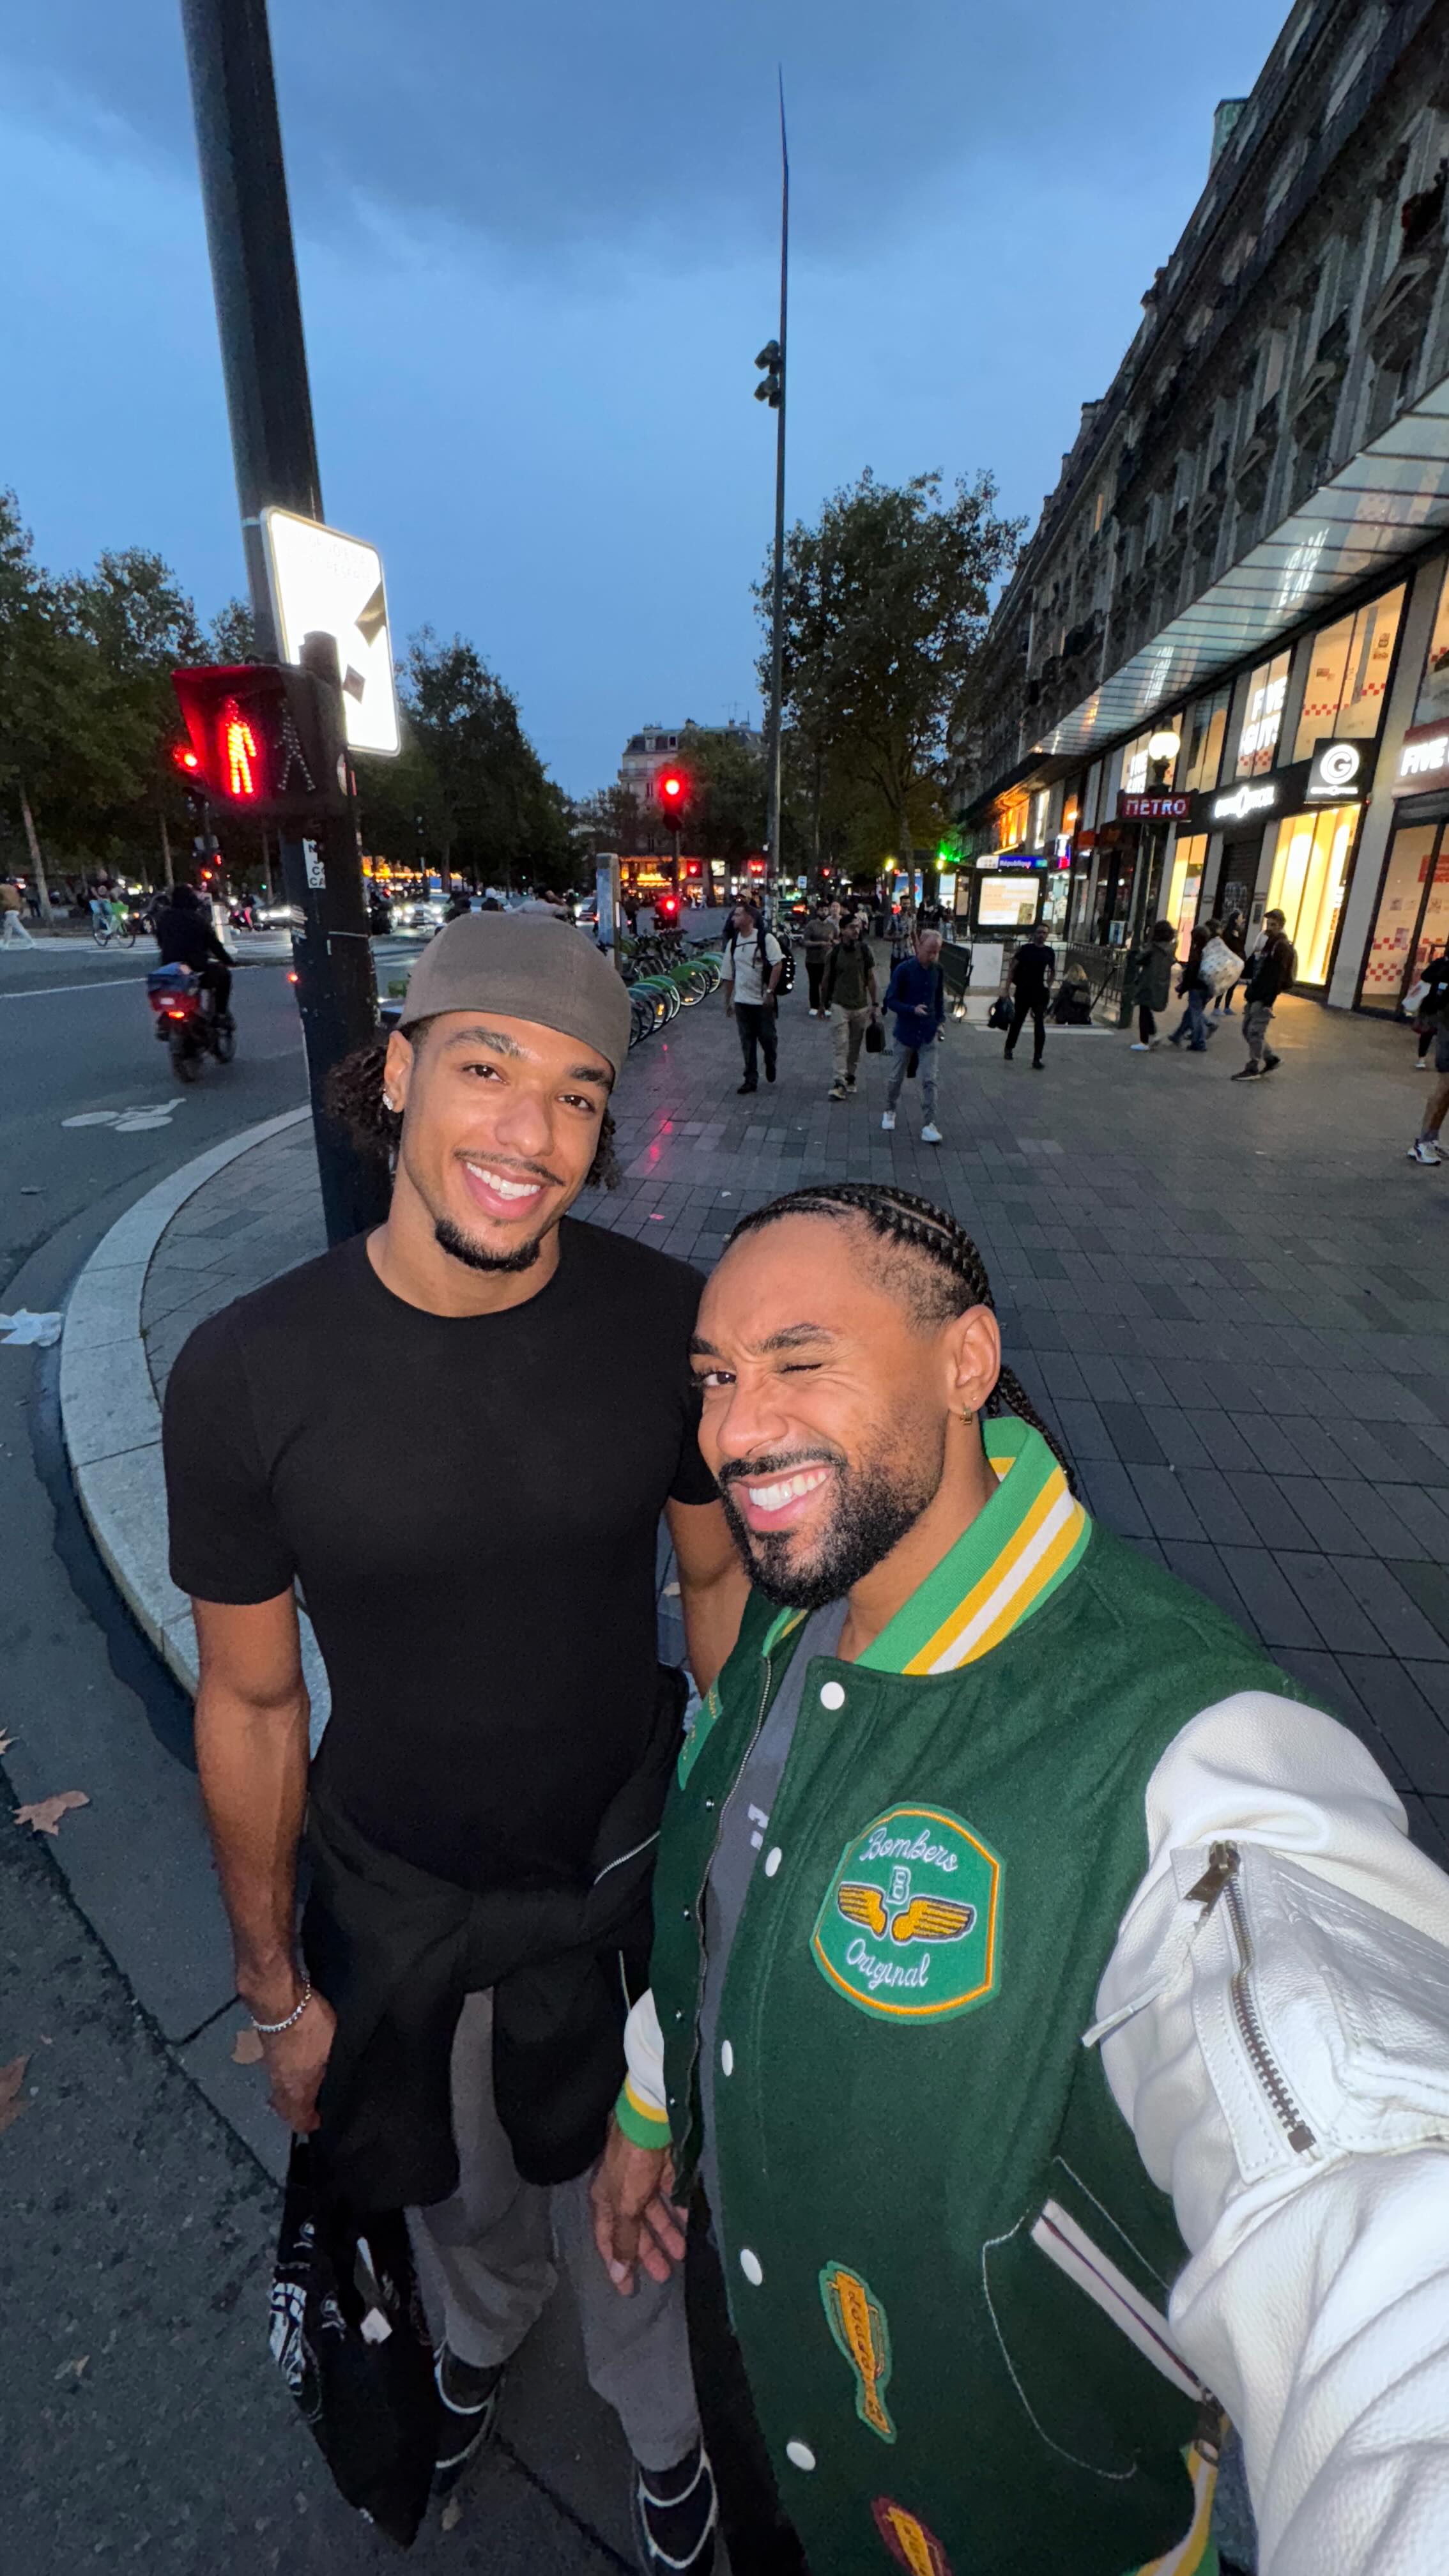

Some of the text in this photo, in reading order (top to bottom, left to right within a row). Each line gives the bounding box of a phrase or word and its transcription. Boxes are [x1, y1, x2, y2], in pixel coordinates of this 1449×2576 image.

[1400, 737, 1449, 776] FIVE
[1126, 799, 1186, 815] METRO
[859, 1827, 958, 1872] Bombers
[885, 1866, 911, 1905] B
[846, 1938, 931, 1989] Original
